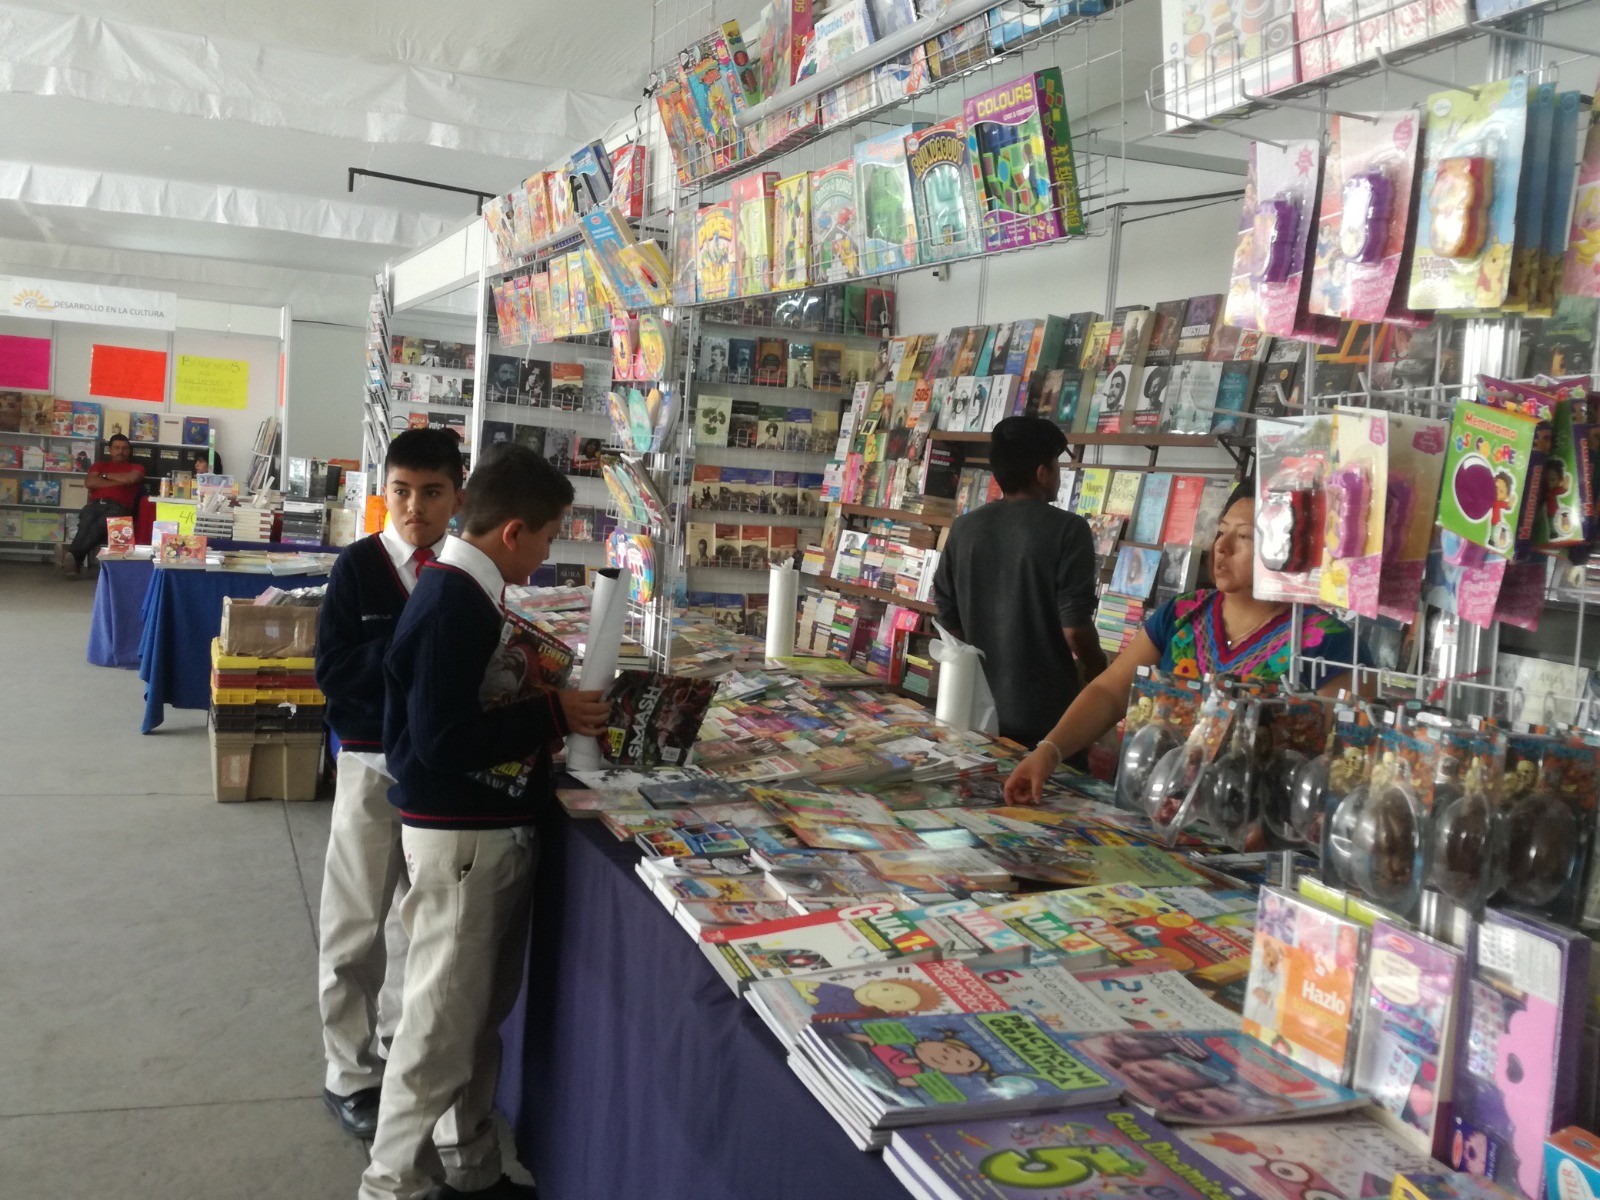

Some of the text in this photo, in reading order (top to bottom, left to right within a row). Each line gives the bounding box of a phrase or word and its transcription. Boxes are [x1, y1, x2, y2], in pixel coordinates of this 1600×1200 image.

[977, 82, 1034, 118] COLOURS
[697, 216, 732, 249] PIPES
[54, 300, 165, 319] DESARROLLO EN LA CULTURA
[914, 388, 931, 401] SOS
[559, 570, 581, 579] AURA
[628, 685, 662, 759] SMASH
[837, 902, 911, 941] GUÍA
[1061, 937, 1093, 951] 4
[1120, 948, 1158, 961] 5
[981, 968, 1024, 985] 6
[1100, 977, 1143, 993] 2
[1301, 979, 1346, 1015] Hazlo
[979, 1144, 1134, 1189] 5
